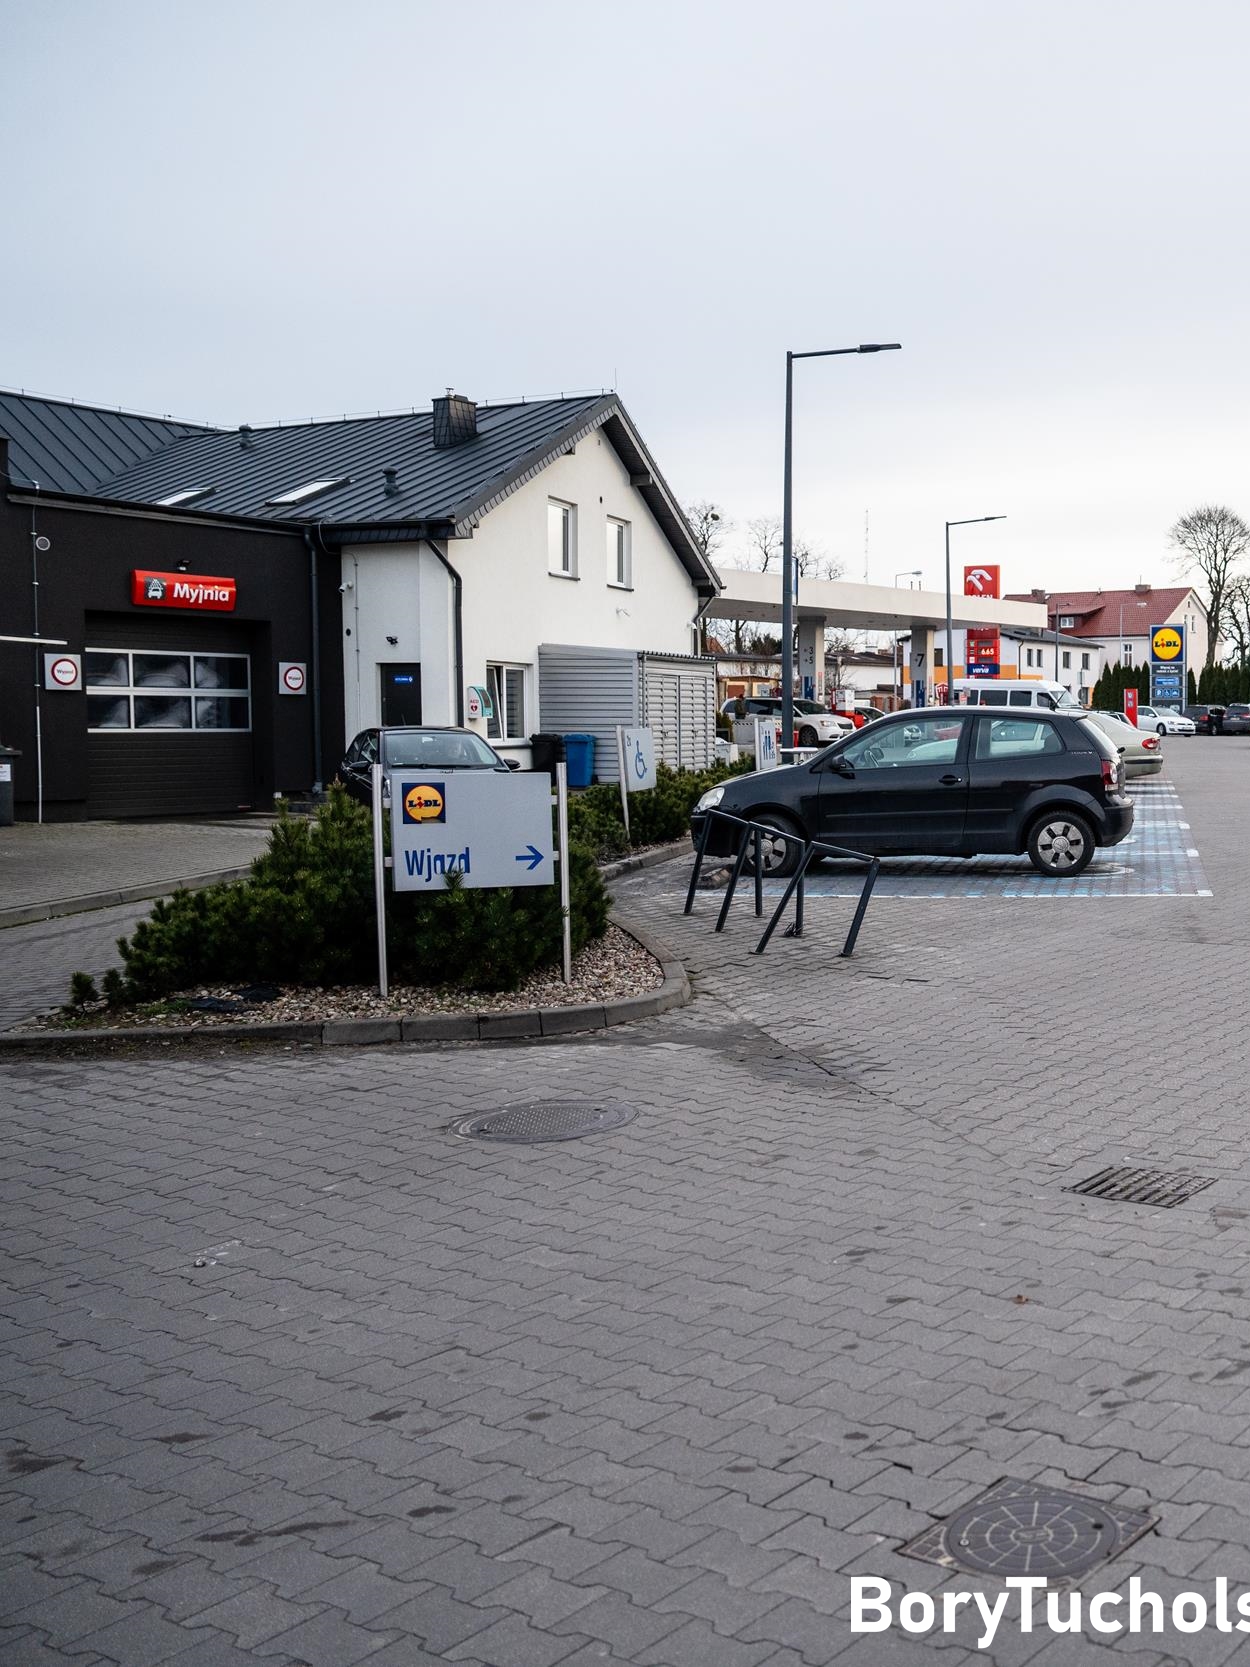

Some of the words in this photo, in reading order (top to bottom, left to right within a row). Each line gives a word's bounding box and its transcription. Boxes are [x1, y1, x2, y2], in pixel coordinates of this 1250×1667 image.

[173, 582, 229, 604] Myjnia
[917, 653, 925, 667] 7
[404, 846, 471, 883] Wjazd
